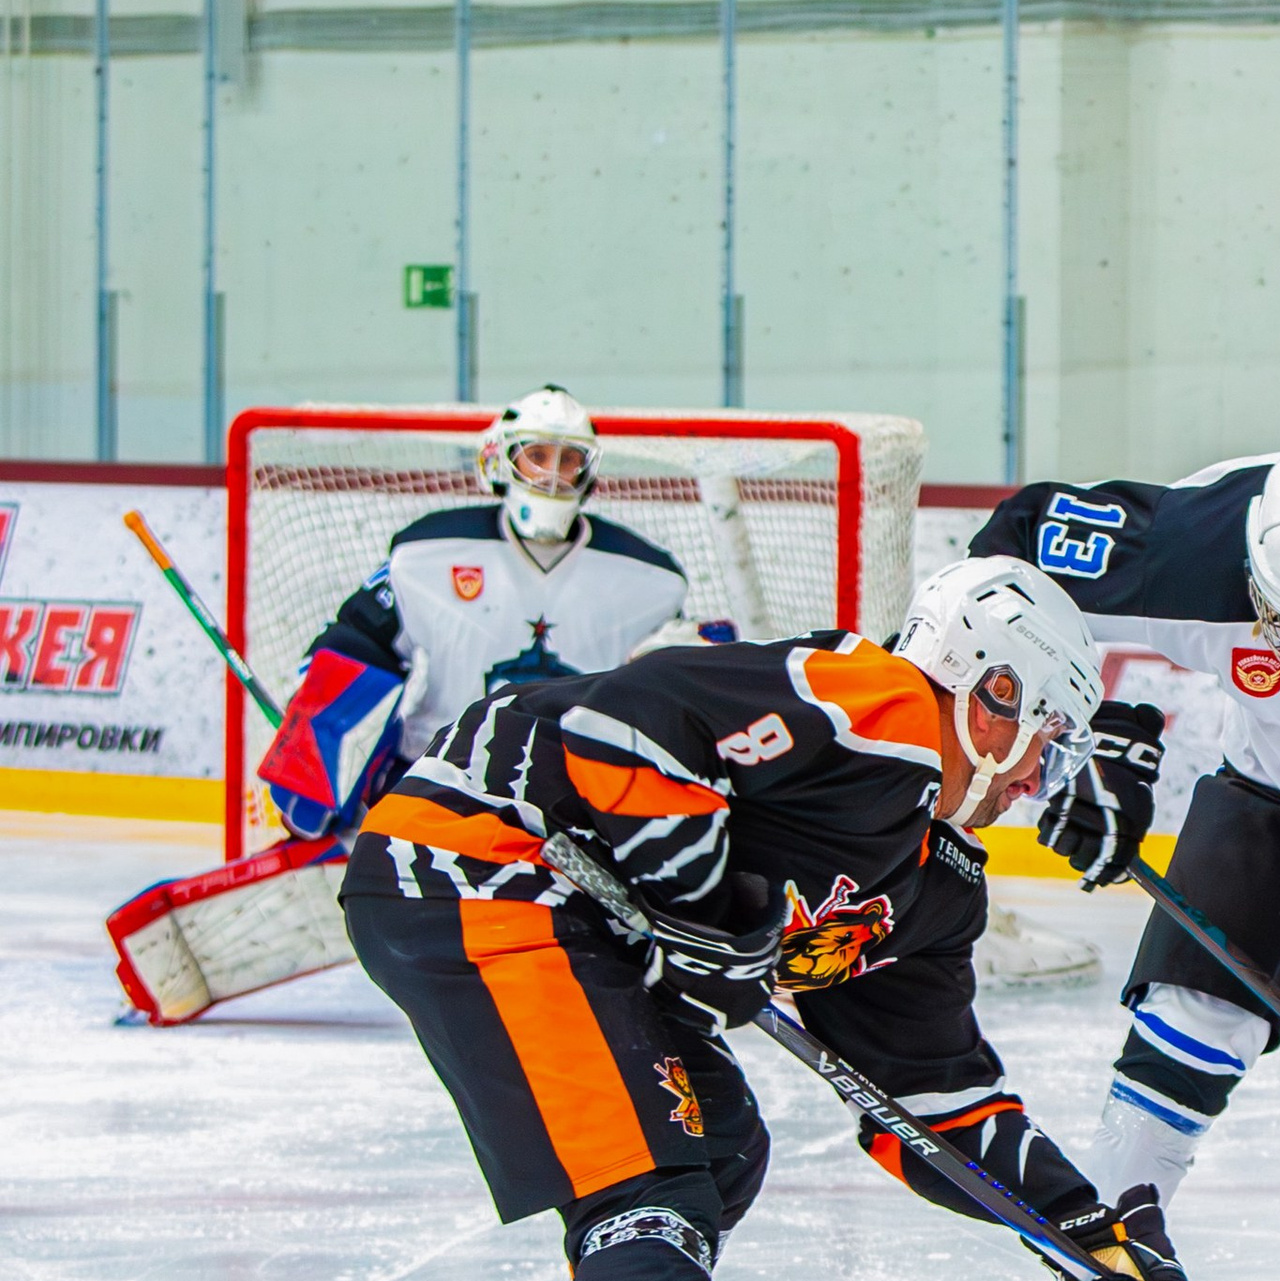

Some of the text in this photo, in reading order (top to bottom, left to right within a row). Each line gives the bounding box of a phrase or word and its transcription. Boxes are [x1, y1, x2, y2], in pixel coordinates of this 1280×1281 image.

[1038, 492, 1127, 579] 13
[1015, 623, 1056, 658] SOYUZ
[716, 712, 794, 766] 8
[1060, 1208, 1106, 1230] CCM
